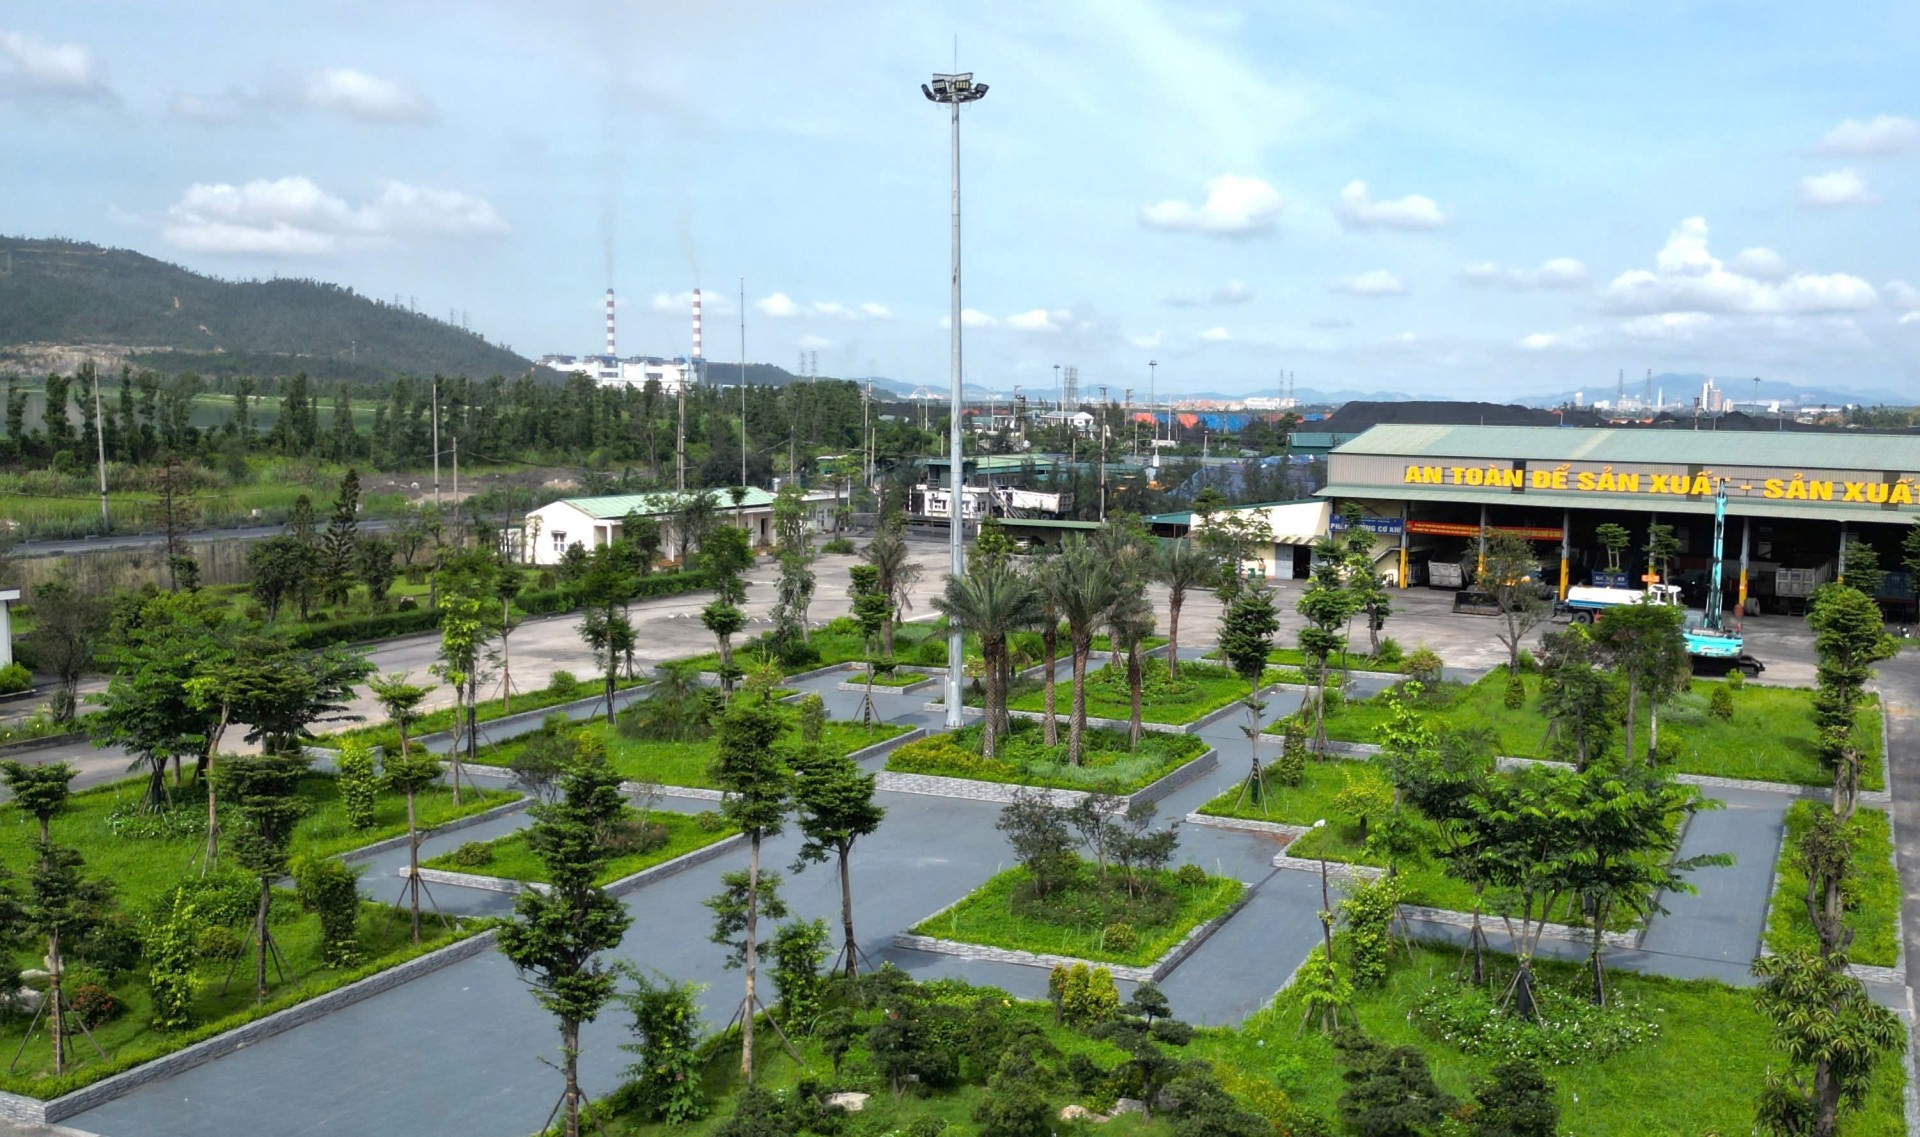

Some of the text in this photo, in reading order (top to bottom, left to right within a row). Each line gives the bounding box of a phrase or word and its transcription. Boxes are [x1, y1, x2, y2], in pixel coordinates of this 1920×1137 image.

[1404, 465, 1443, 484] AN
[1451, 463, 1524, 487] TOÀN
[1532, 463, 1571, 489] ĐỂ
[1577, 465, 1639, 492] SẢN
[1763, 472, 1834, 500] SẢN
